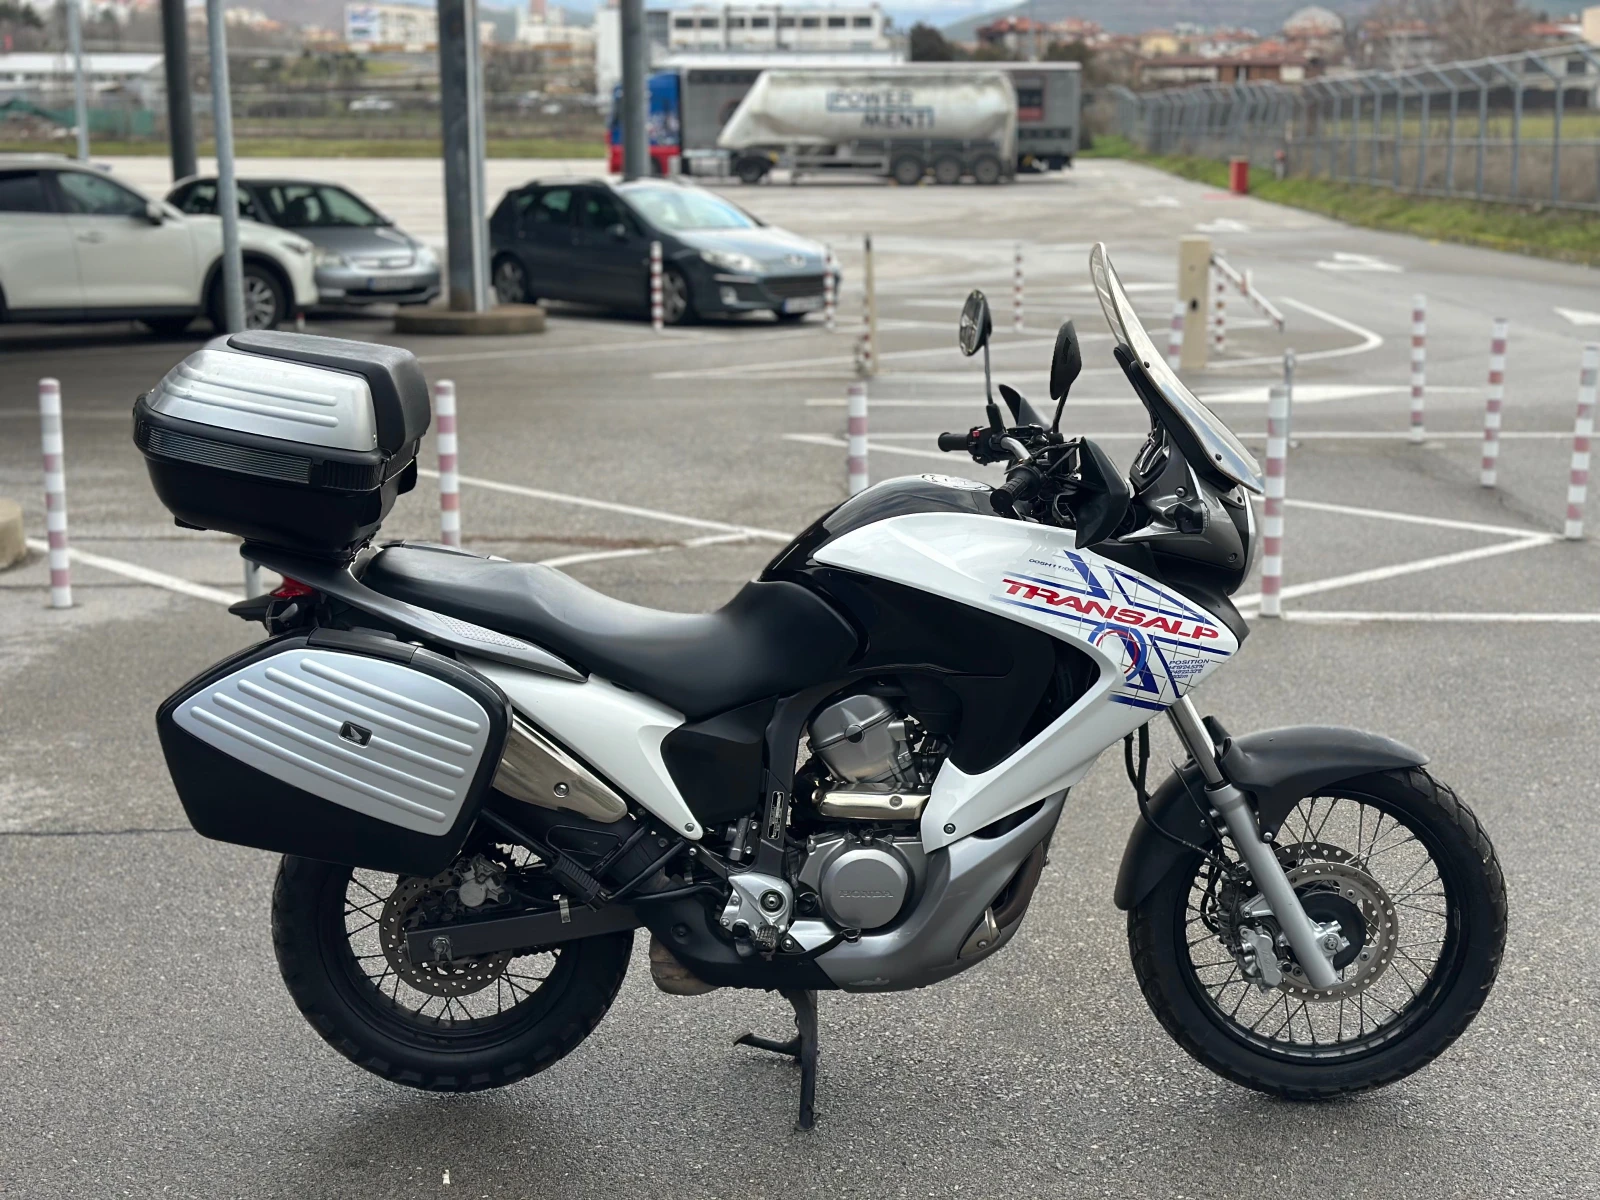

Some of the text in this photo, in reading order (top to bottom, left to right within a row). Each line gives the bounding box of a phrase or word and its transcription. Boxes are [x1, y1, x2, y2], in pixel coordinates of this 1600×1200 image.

[831, 90, 914, 108] POWER
[1003, 578, 1219, 640] TRANSALP
[839, 890, 893, 898] HONDA
